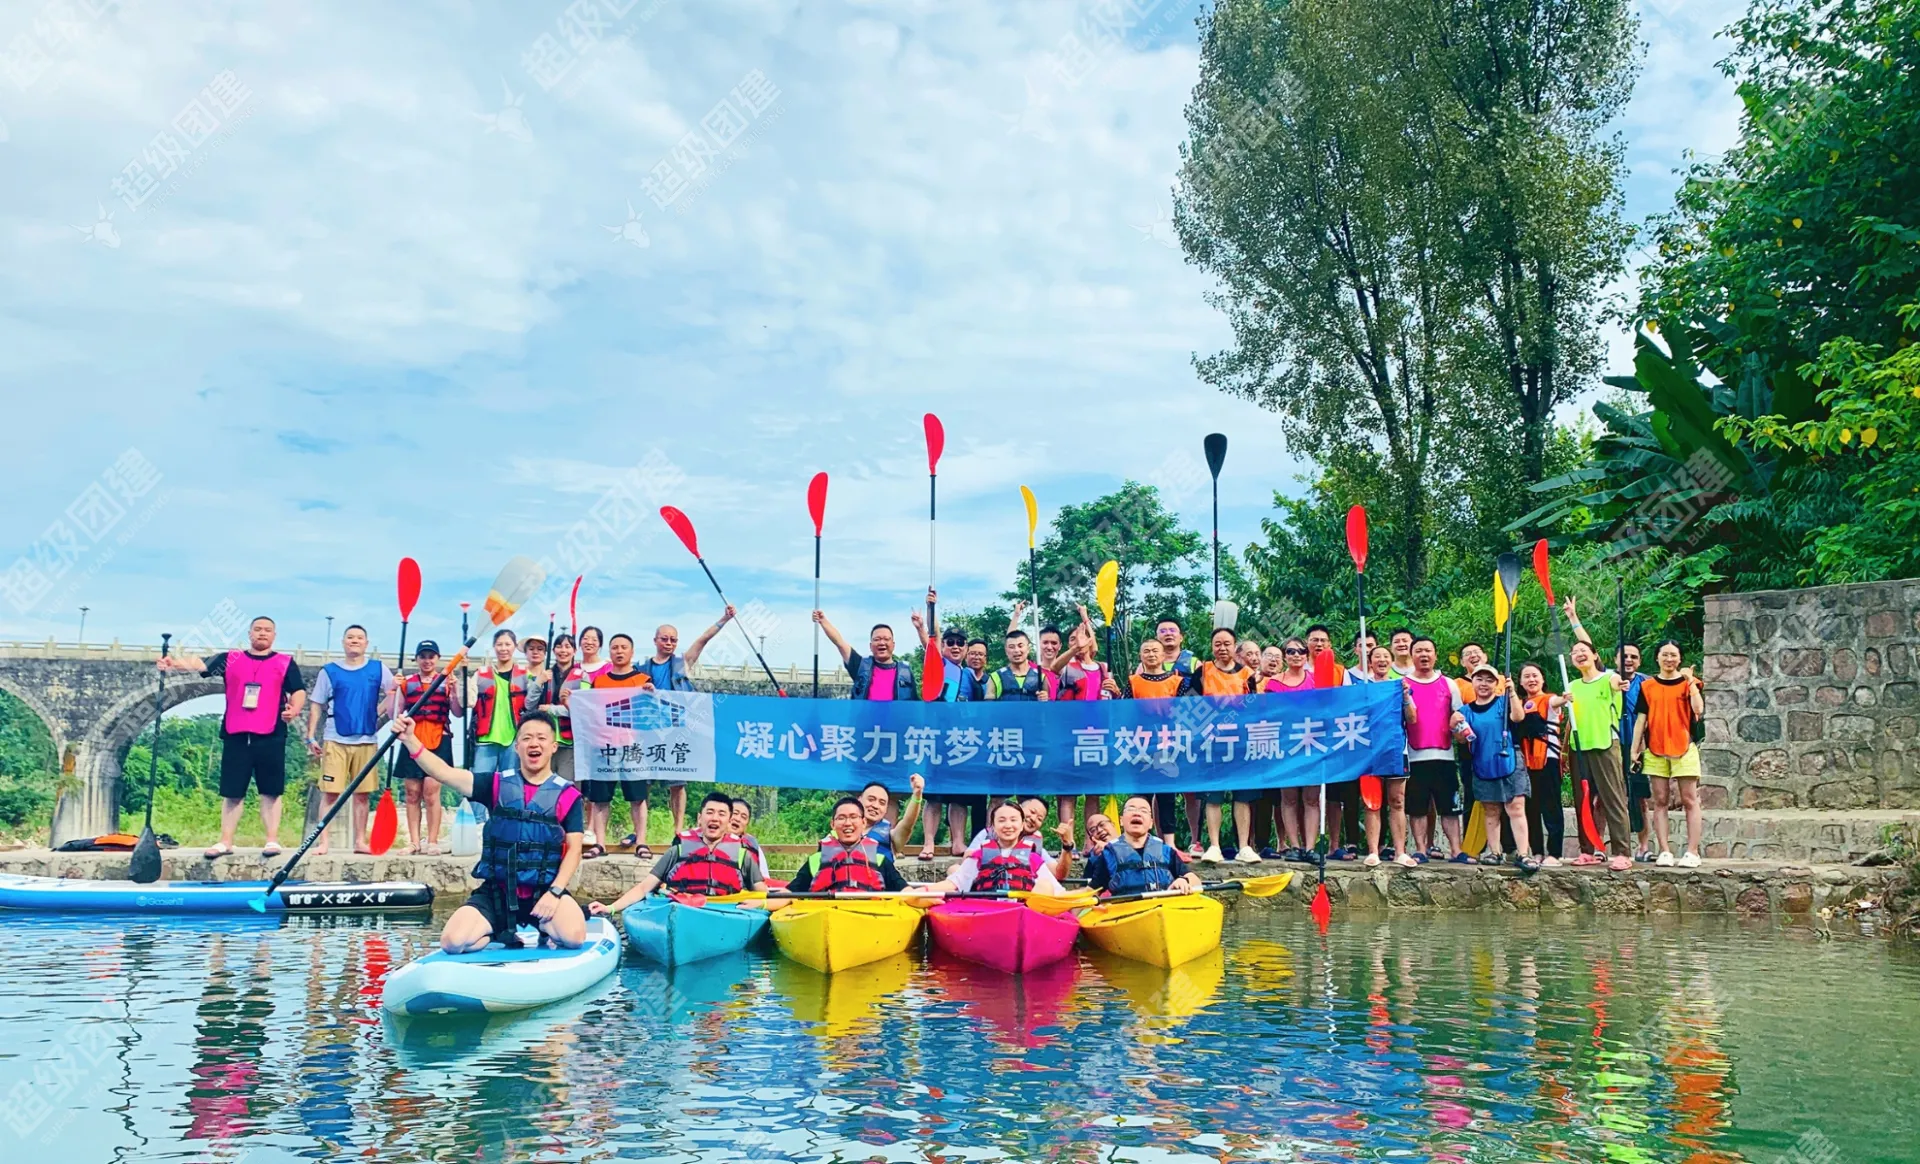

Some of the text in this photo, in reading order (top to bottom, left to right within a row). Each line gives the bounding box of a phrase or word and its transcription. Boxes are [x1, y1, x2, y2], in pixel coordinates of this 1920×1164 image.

[600, 742, 692, 766] 中腾项管
[735, 712, 1372, 770] 凝心聚力筑梦想，高效执行赢未来
